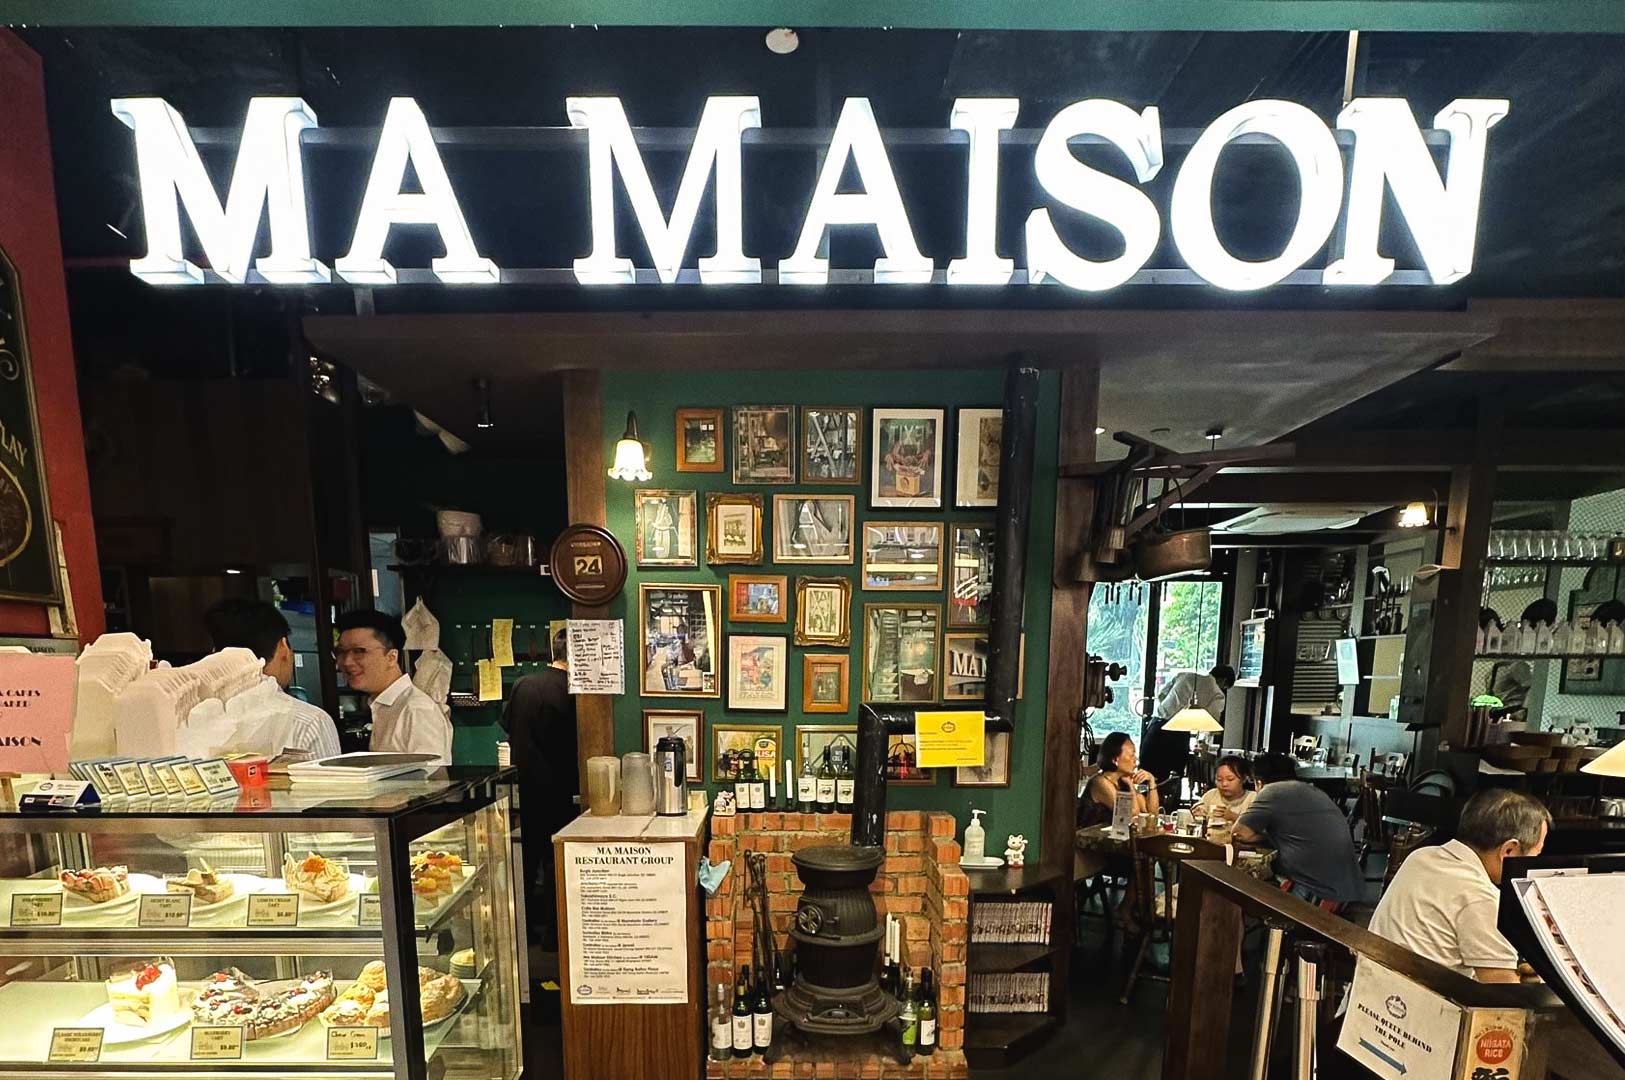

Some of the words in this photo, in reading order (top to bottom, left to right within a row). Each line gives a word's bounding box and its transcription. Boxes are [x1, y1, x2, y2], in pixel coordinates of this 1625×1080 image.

[110, 96, 501, 286] MA
[565, 96, 1511, 292] MAISON
[577, 559, 598, 575] 24
[575, 857, 638, 865] RESTAURANT
[641, 857, 673, 865] GROUP
[1357, 1003, 1380, 1021] PLEASE
[1380, 1017, 1402, 1036] QUEUE
[1402, 1031, 1432, 1053] BEHIND
[1375, 1025, 1388, 1037] THE
[1388, 1034, 1406, 1049] POLE
[1480, 1039, 1511, 1048] NIIGATA
[1484, 1048, 1504, 1058] RICE
